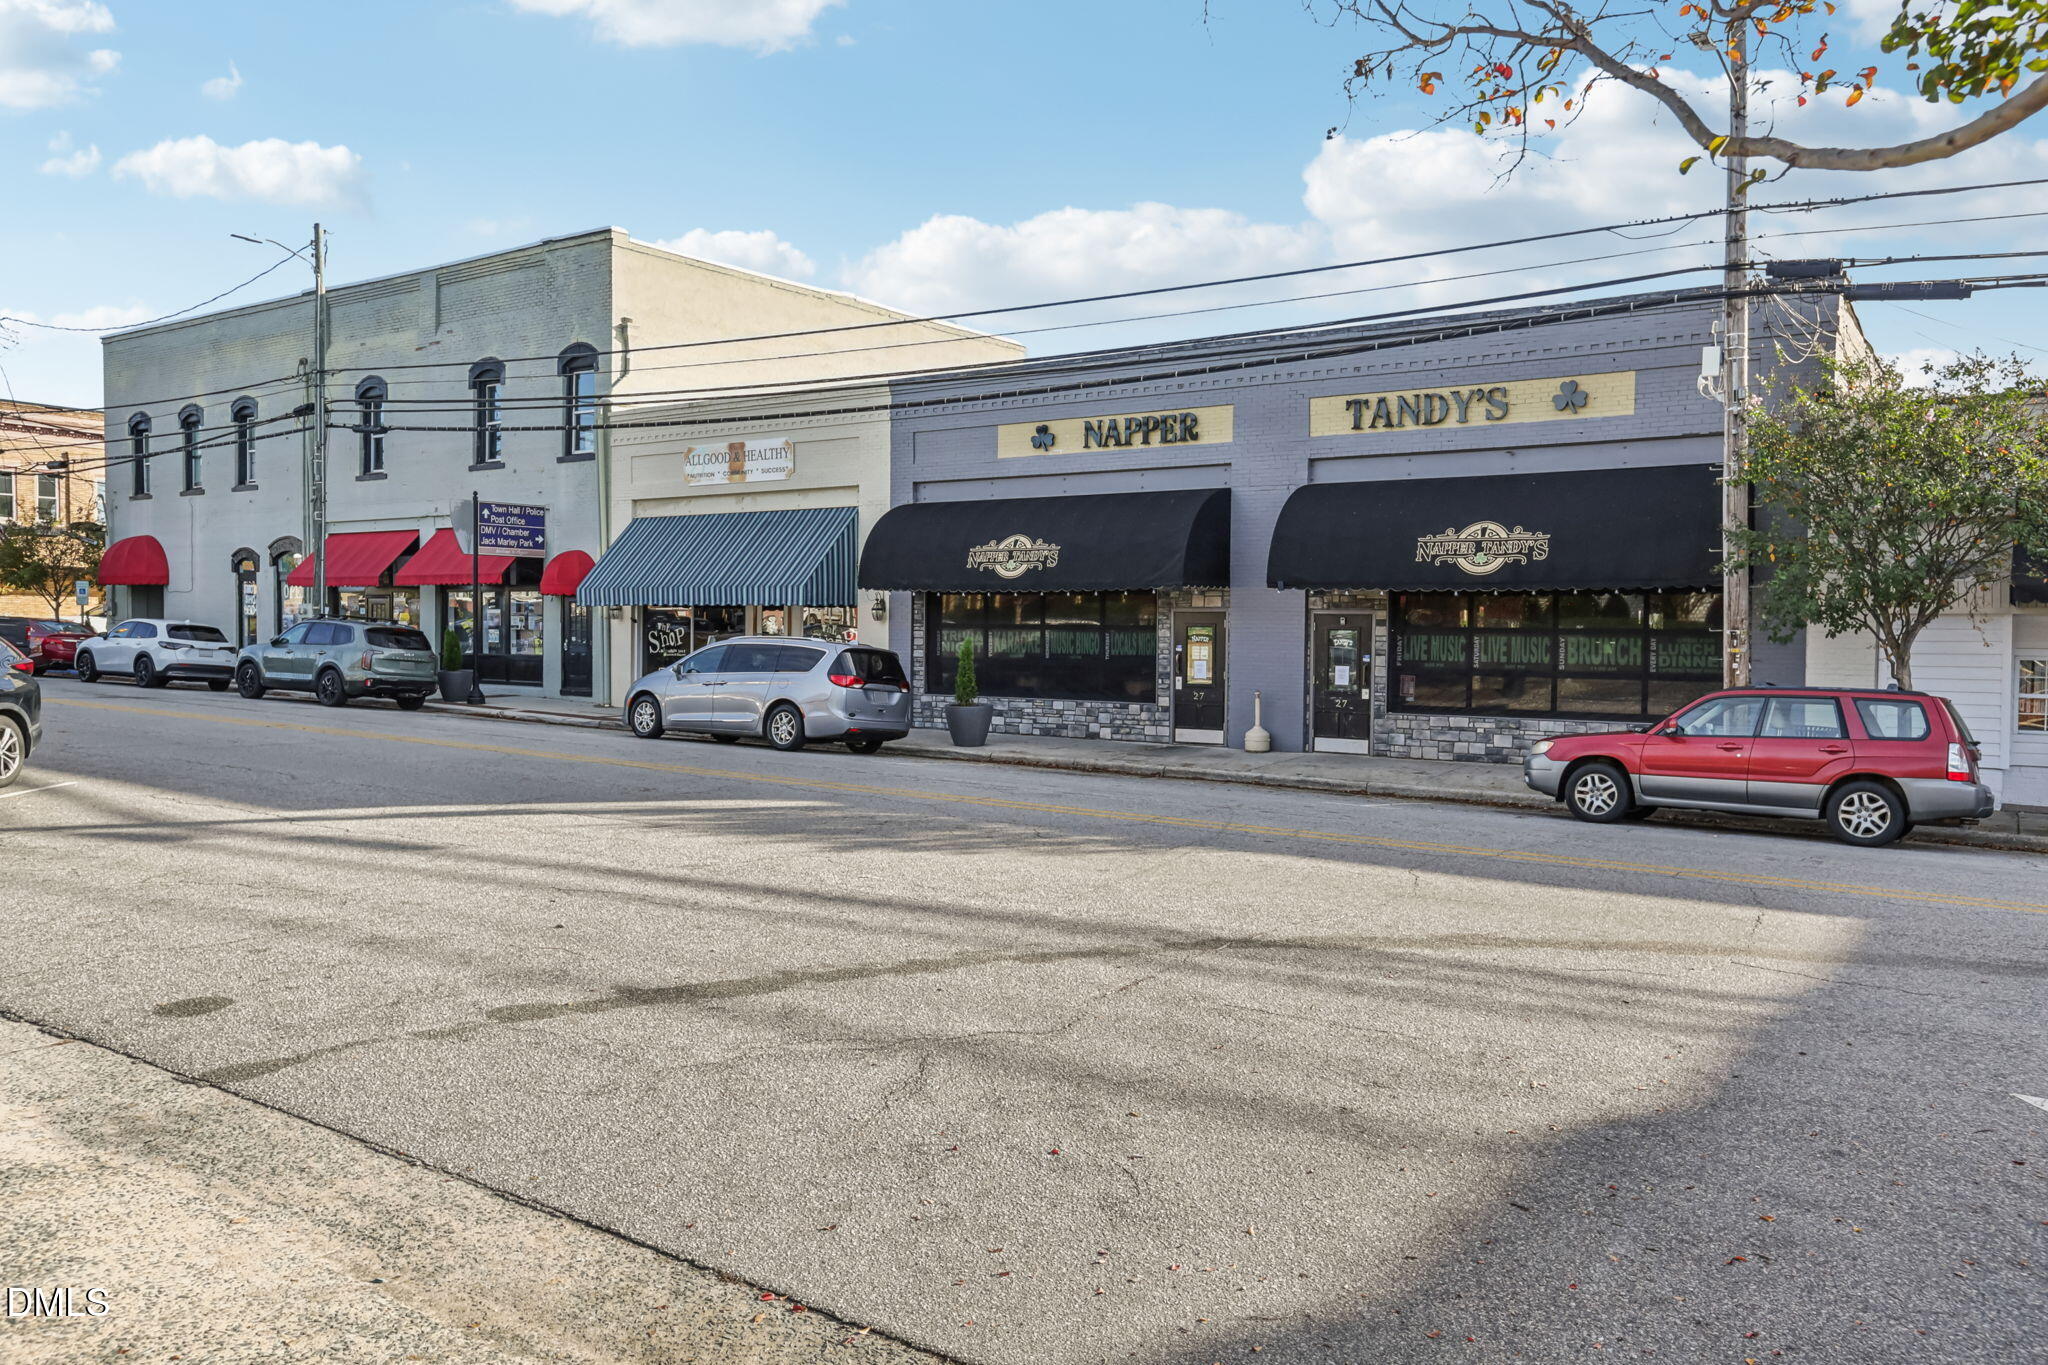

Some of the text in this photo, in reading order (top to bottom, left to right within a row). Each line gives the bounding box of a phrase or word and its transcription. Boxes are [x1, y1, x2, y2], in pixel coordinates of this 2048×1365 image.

[1346, 387, 1508, 430] TANDY'S
[1083, 412, 1198, 448] NAPPER
[685, 447, 790, 466] ALLGOOD & HEALTHY
[490, 504, 507, 514] Town
[508, 506, 520, 515] Hall
[526, 508, 544, 516] Police
[490, 516, 526, 526] Post Office
[480, 526, 496, 534] DMV
[502, 527, 530, 536] Chamber
[481, 537, 534, 548] Jack Marley Park
[1416, 540, 1549, 562] NAPPER TANDY'S
[966, 550, 1058, 568] NAPPER TANDY'S
[994, 631, 1041, 653] KARAOKE
[1050, 632, 1074, 654] MUSIC
[1076, 632, 1100, 655] BINGO
[1403, 635, 1466, 662] LIVE MUSIC
[1480, 636, 1550, 664] LIVE MUSIC
[1568, 637, 1642, 665] BRUNCH
[1659, 644, 1715, 655] LUNCH
[1659, 656, 1722, 668] DINNE
[1336, 700, 1347, 708] 27
